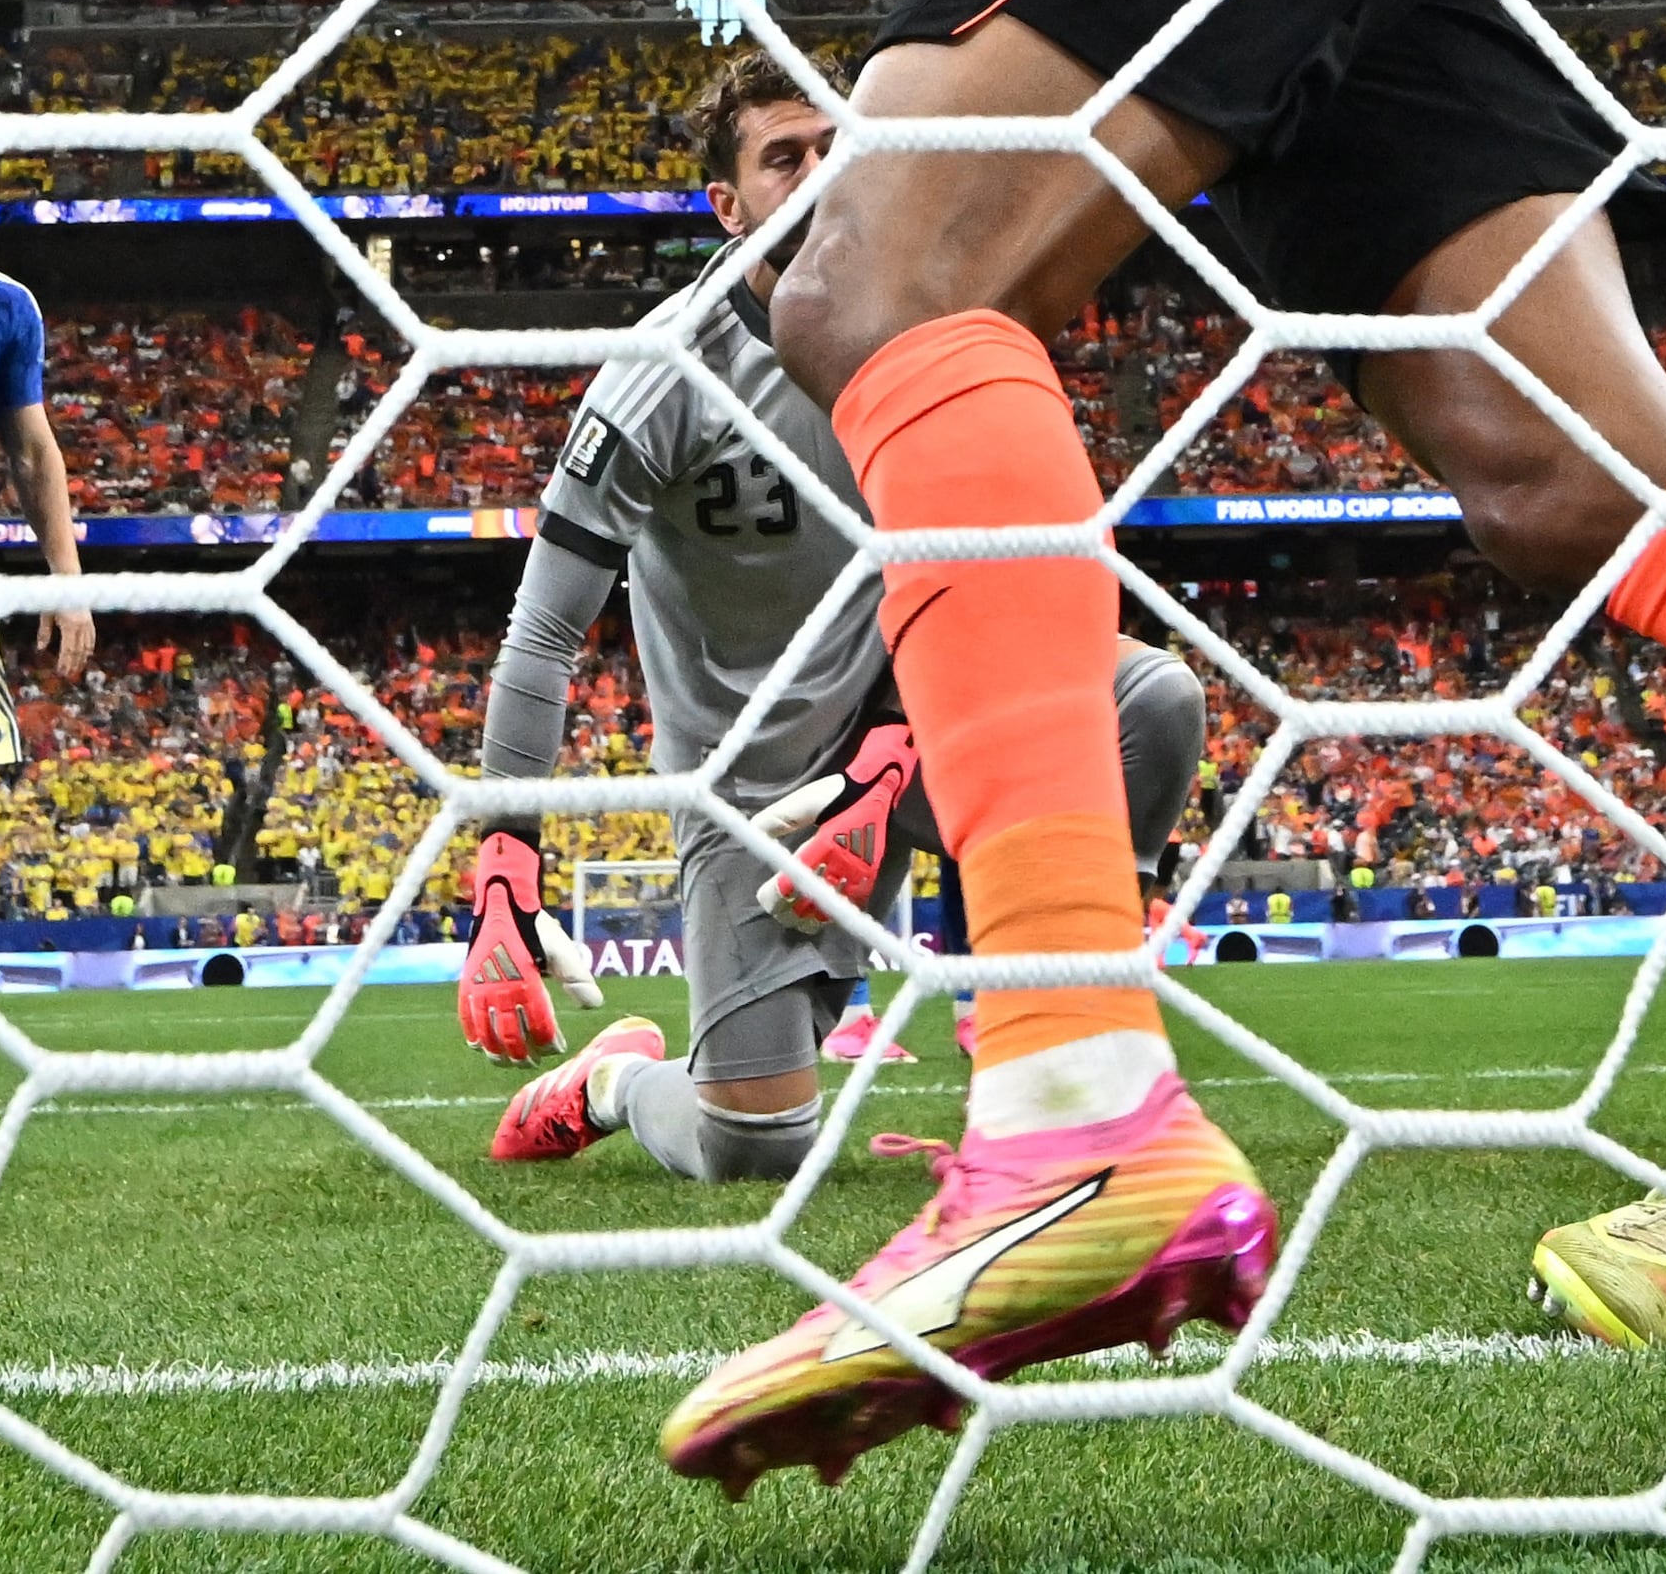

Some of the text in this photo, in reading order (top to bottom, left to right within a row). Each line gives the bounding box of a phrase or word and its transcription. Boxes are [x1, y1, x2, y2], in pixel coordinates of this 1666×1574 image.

[499, 194, 589, 212] HOUSTON
[693, 454, 799, 536] 23
[1216, 499, 1264, 521] FIFA
[1264, 498, 1345, 520] WORLD
[1345, 497, 1390, 518] CUP
[585, 938, 685, 977] ATA
